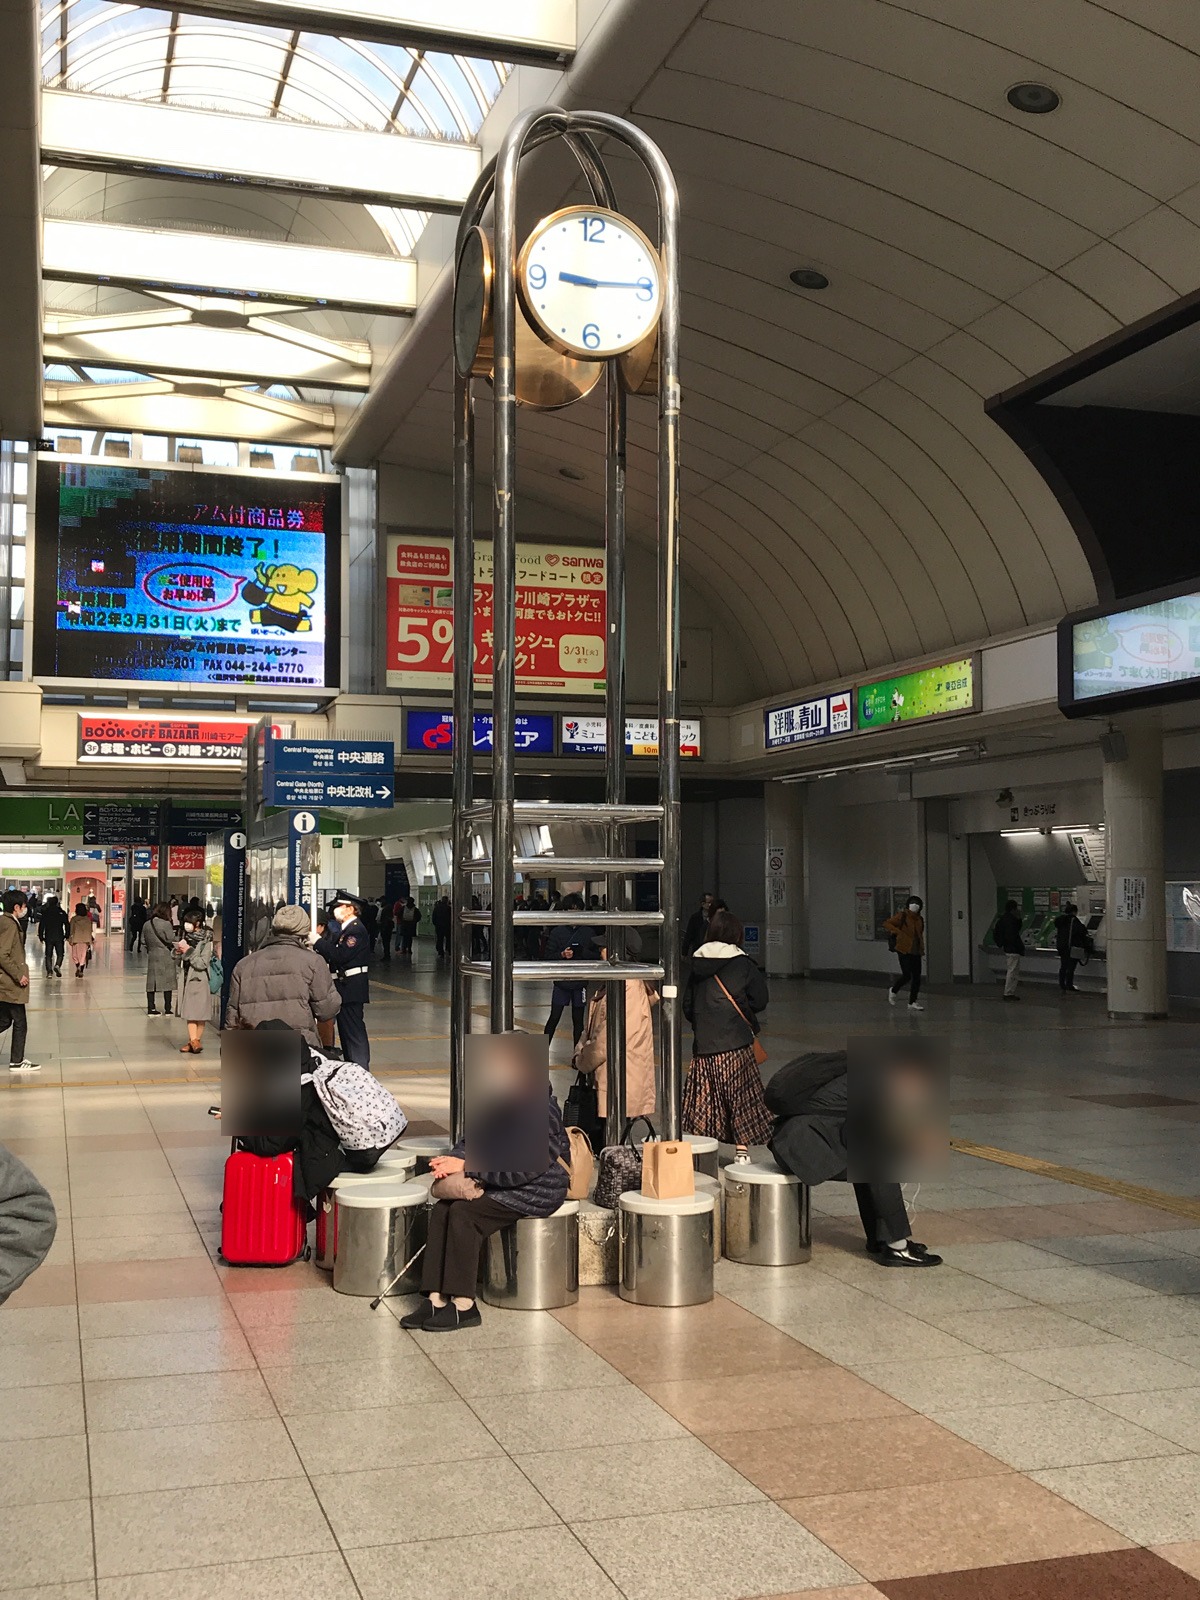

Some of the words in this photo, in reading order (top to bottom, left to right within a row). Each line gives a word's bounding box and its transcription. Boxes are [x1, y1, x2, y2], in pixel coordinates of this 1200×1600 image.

[578, 217, 605, 243] 12
[529, 264, 547, 290] 9
[636, 277, 654, 302] 3
[582, 323, 601, 349] 6
[562, 556, 604, 568] sanwa
[581, 571, 603, 584] 限定
[203, 658, 222, 671] FAX
[774, 704, 822, 736] 洋服の青山
[832, 711, 848, 721] モアーズ
[159, 729, 199, 740] BAZAAR
[86, 744, 98, 752] 3F
[101, 743, 161, 755] 家電・ホビー
[164, 745, 176, 753] 6F
[303, 747, 335, 755] Passageway
[337, 751, 385, 764] 中央通路
[326, 785, 374, 798] 中央北改札
[170, 852, 204, 860] キャッシュ
